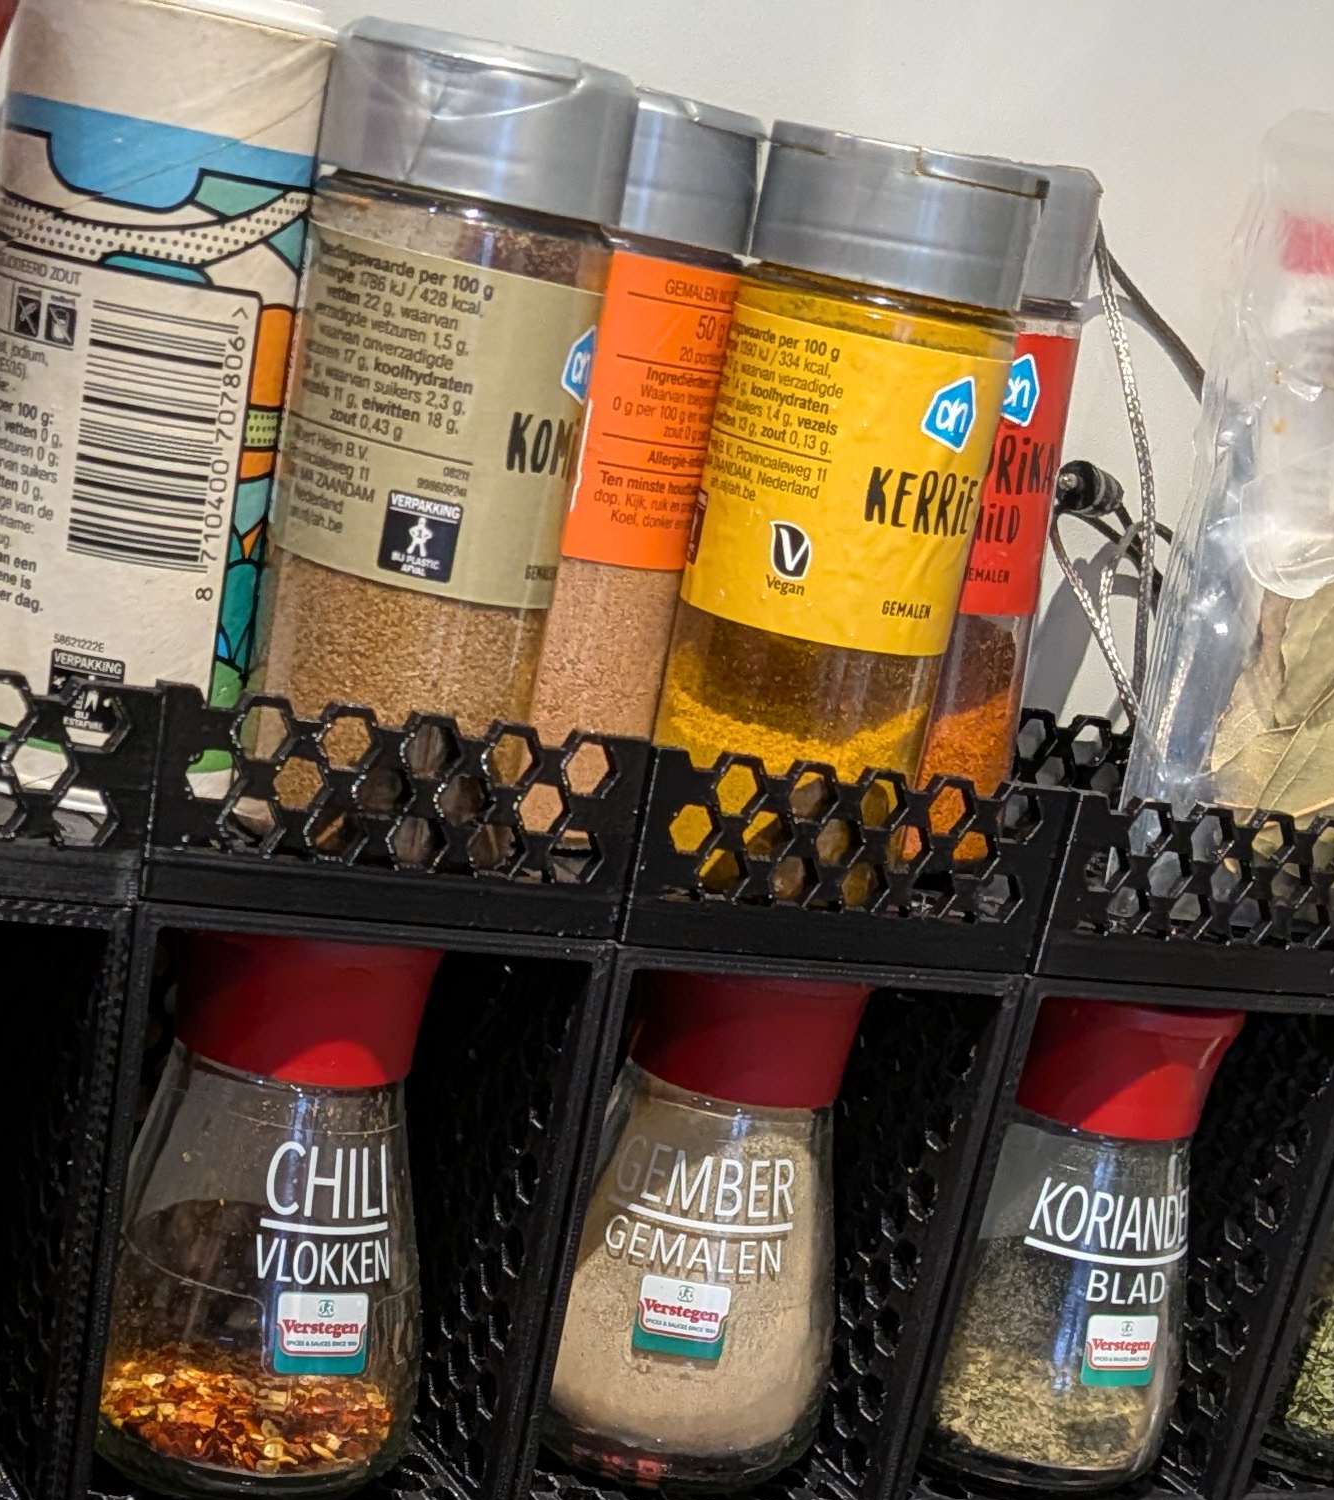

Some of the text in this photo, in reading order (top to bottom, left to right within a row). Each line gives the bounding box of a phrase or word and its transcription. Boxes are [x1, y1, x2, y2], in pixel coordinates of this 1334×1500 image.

[50, 266, 82, 285] ZOUT
[419, 269, 494, 301] per 100 g
[420, 287, 447, 307] 428
[400, 306, 459, 330] waarvan
[696, 314, 716, 341] 50
[679, 346, 694, 363] 20
[778, 335, 840, 362] per 100 g
[778, 351, 800, 370] 334
[373, 357, 474, 395] koolhydraten
[778, 373, 844, 399] verzadigde
[373, 381, 422, 403] suikers
[750, 381, 829, 415] koolhydraten
[18, 402, 38, 420] 100
[329, 408, 357, 427] zout
[361, 397, 443, 430] eiwitten 18
[636, 403, 678, 421] per 100
[40, 427, 49, 443] 0
[760, 425, 787, 442] zout
[797, 416, 838, 436] vezels
[36, 446, 45, 461] 0
[736, 444, 828, 482] Provincialeweg 11
[20, 463, 58, 484] suikers
[195, 335, 246, 602] 8 710400 707806
[21, 479, 30, 495] 0
[600, 470, 665, 493] Ten minste
[756, 471, 820, 499] Nederland
[15, 500, 35, 516] van
[37, 505, 54, 521] de
[391, 492, 460, 520] VERPAKKING
[13, 556, 37, 573] een
[406, 554, 440, 570] PLASTIC
[20, 574, 32, 590] is
[765, 574, 806, 597] Vegan
[14, 591, 44, 614] dag.
[881, 599, 931, 620] GEMALEN
[53, 650, 123, 675] VERPAKKING
[266, 1141, 389, 1219] CHILI
[617, 1135, 795, 1219] GEMBER
[605, 1214, 782, 1275] GEMALEN
[256, 1233, 391, 1286] VLOKKEN
[1086, 1269, 1167, 1306] BLAD
[643, 1297, 720, 1324] Verstegen
[282, 1318, 360, 1338] Verstegen
[1092, 1337, 1151, 1355] Verstegen
